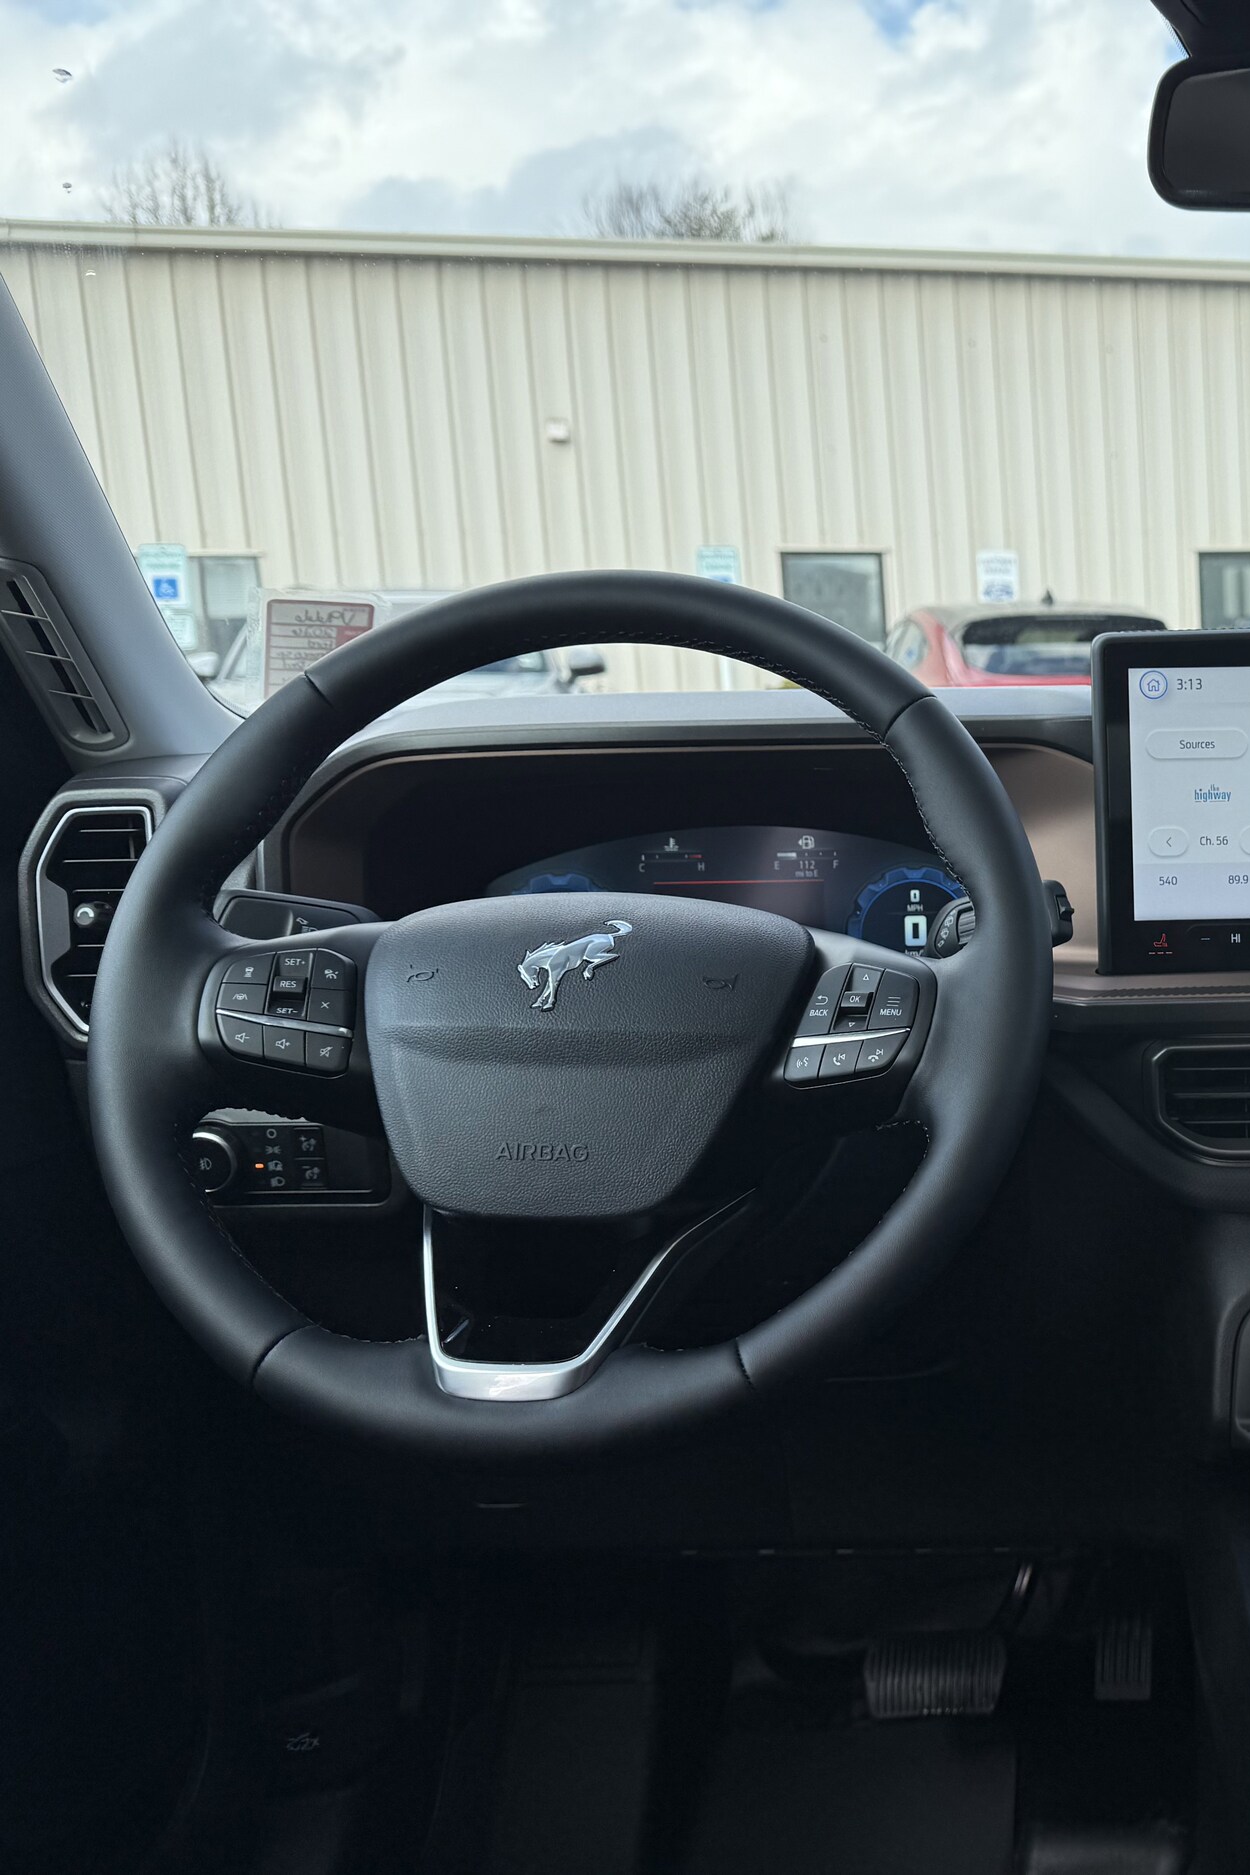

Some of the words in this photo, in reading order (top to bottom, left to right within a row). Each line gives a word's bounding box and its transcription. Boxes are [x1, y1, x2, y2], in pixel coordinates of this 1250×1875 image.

[1176, 678, 1203, 691] 3:13
[1179, 740, 1215, 750] Sources
[1194, 788, 1231, 802] highway
[1199, 836, 1214, 846] Ch.
[1216, 836, 1228, 846] 56
[639, 863, 645, 872] C
[698, 863, 705, 871] H
[774, 861, 780, 870] E
[799, 861, 815, 869] 112
[833, 861, 839, 869] F
[1159, 876, 1177, 886] 540
[1228, 875, 1249, 884] 89.9
[910, 890, 920, 902] 0
[907, 904, 923, 912] MPH
[904, 915, 927, 946] 0
[1231, 933, 1240, 943] HI
[285, 958, 305, 966] SET+
[496, 1142, 589, 1162] AIRBAG
